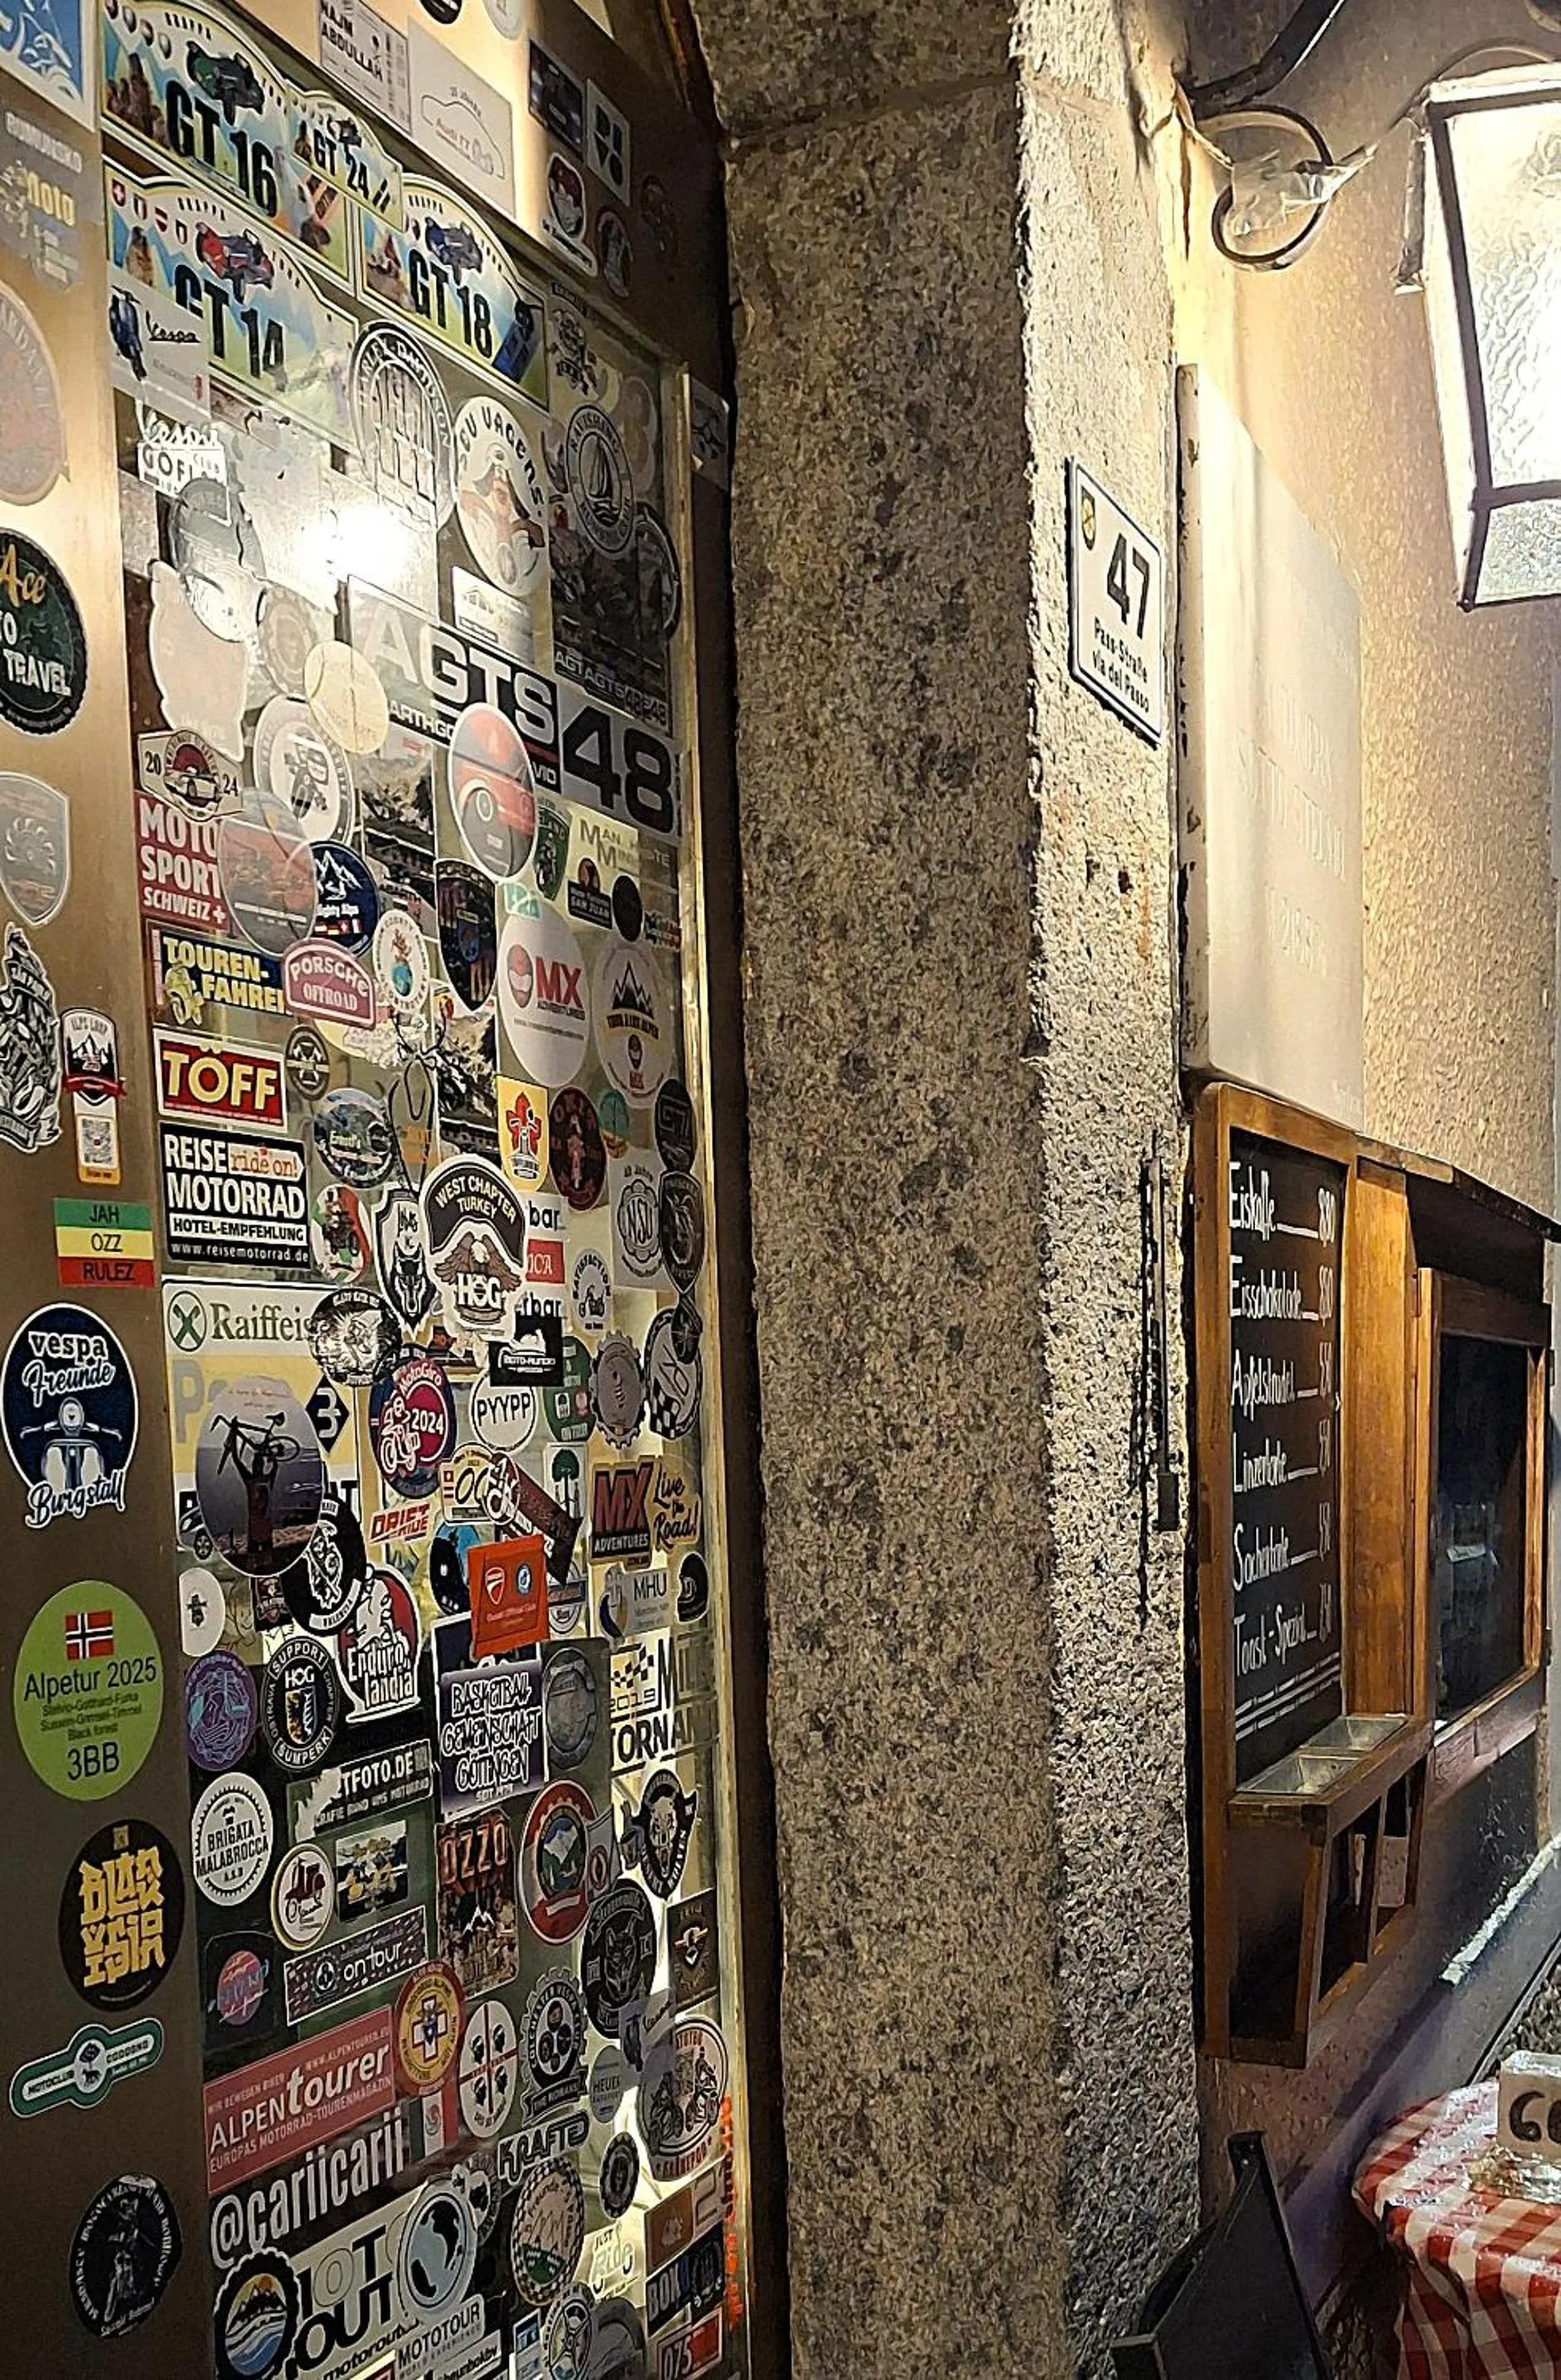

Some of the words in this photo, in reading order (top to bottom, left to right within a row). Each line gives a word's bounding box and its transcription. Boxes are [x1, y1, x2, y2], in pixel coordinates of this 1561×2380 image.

[320, 22, 384, 80] ABDULLAH
[166, 80, 220, 165] GT
[230, 129, 278, 218] 16
[314, 128, 337, 177] GT
[345, 144, 370, 200] 24
[410, 248, 448, 330] GT
[458, 285, 492, 358] 18
[145, 310, 201, 344] Vespa
[1107, 532, 1150, 639] 47
[3, 648, 71, 696] TRAVEL
[1093, 650, 1106, 676] Via
[1108, 665, 1122, 691] del
[1124, 676, 1150, 713] Passo
[144, 751, 162, 776] 20
[563, 705, 673, 833] 48
[222, 774, 239, 797] 24
[140, 845, 221, 899] SPORT
[143, 887, 210, 923] SCHWEIZ
[164, 936, 270, 983] TOUREN-
[201, 974, 285, 1015] FAHRE
[303, 982, 358, 1011] OFFROAD
[536, 957, 583, 1010] MX
[165, 1133, 227, 1173] REISE
[230, 1150, 269, 1174] ride
[273, 1155, 298, 1178] on!
[89, 1204, 120, 1224] JAH
[167, 1172, 306, 1219] MOTORRAD
[436, 1175, 466, 1209] WEST
[468, 1175, 516, 1225] CHAPTER
[457, 1196, 498, 1219] TURKEY
[91, 1233, 122, 1253] OZZ
[173, 1218, 304, 1241] HOTEL-EMPFEHLUNG
[84, 1262, 133, 1282] RULEZ
[172, 1243, 308, 1263] www.reisemotorrad.de
[22, 1360, 117, 1408] Freunde
[399, 1361, 443, 1395] MotoGiro
[411, 1408, 444, 1435] 2024
[477, 1392, 531, 1427] PYYPP
[25, 1468, 125, 1529] Burgstall
[594, 1462, 655, 1533] MX
[653, 1462, 686, 1509] Live
[594, 1534, 649, 1554] ADVENTURES
[633, 1572, 667, 1602] MHU
[272, 1641, 327, 1675] SUPPORT
[285, 1665, 315, 1689] HOG
[348, 1643, 405, 1682] Enduro
[23, 1670, 101, 1704] Alpetur
[107, 1657, 157, 1688] 2025
[365, 1666, 414, 1709] landia
[67, 1741, 120, 1781] 3BB
[338, 1752, 414, 1798] TFOTO.DE
[196, 1835, 269, 1878] MALABROCCA
[207, 1819, 255, 1852] BRIGATA
[343, 1959, 366, 1981] on
[366, 1941, 403, 1970] tour
[211, 2044, 390, 2155] ALPENtourer
[210, 2138, 257, 2174] EUROPAS
[259, 2076, 392, 2149] MOTORRAD-TOURENMAGAZIN
[211, 2106, 405, 2270] @cariicarii
[399, 2303, 480, 2366] MOTOTOUR
